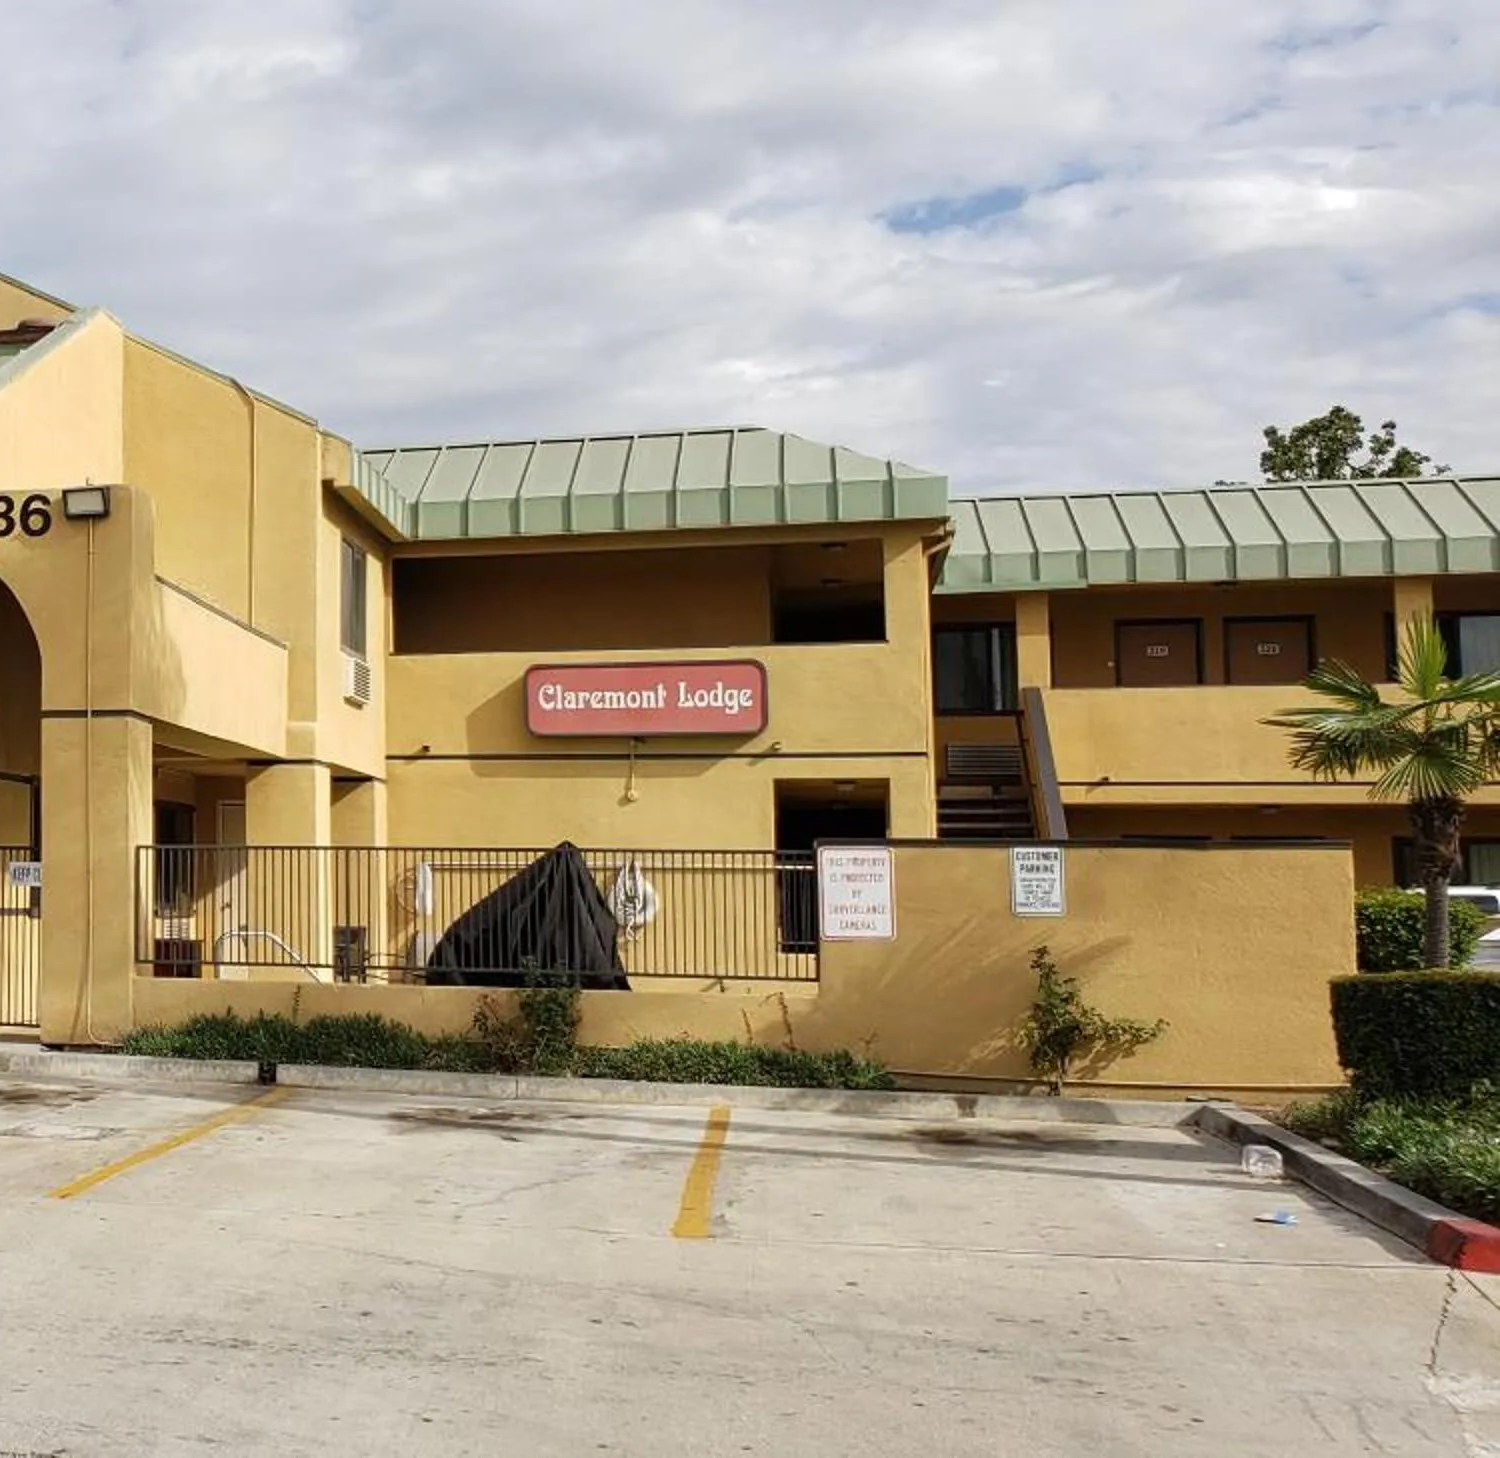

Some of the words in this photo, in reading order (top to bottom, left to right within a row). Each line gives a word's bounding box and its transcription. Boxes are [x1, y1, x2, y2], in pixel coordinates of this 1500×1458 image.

[538, 684, 666, 710] Claremont
[677, 681, 753, 714] Lodge
[1016, 851, 1058, 861] CUSTOMER
[1020, 863, 1055, 874] PARKING
